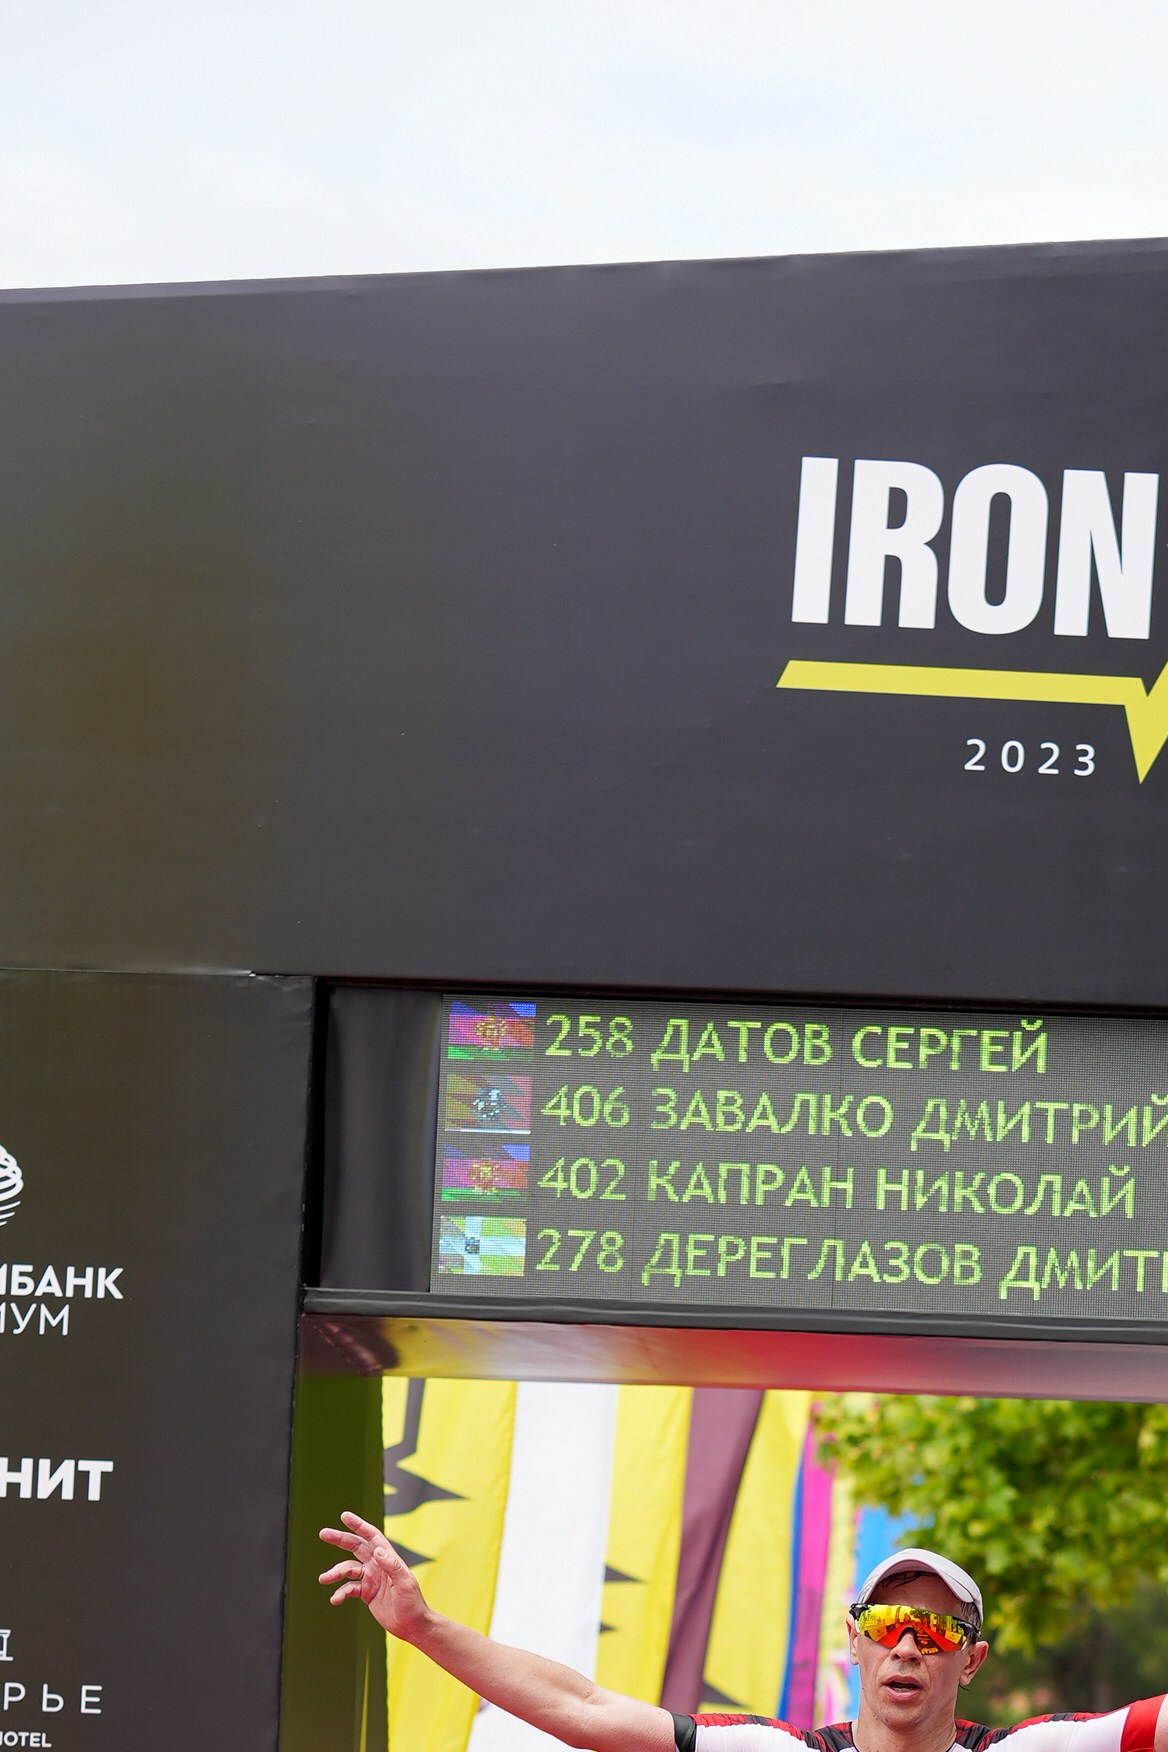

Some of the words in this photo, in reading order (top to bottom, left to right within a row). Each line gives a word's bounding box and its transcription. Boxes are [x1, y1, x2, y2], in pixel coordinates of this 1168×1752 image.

[792, 457, 1158, 639] IRON
[964, 738, 1096, 776] 2023
[545, 1014, 635, 1058] 258
[650, 1017, 833, 1073] ДАТОВ
[852, 1018, 1048, 1074] СЕРГЕЙ
[540, 1084, 630, 1128] 406
[650, 1086, 895, 1138] ЗАВАЛКО
[537, 1156, 628, 1201] 402
[647, 1159, 855, 1210] КАПРАН
[876, 1164, 1136, 1219] НИКОЛАЙ
[0, 1263, 124, 1300] БАНК
[536, 1228, 626, 1274] 278
[641, 1232, 983, 1287] ДЕРЕГЛАЗОВ
[0, 1302, 70, 1336] УМ
[0, 1457, 114, 1501] НИТ
[0, 1731, 52, 1748] OTEL
